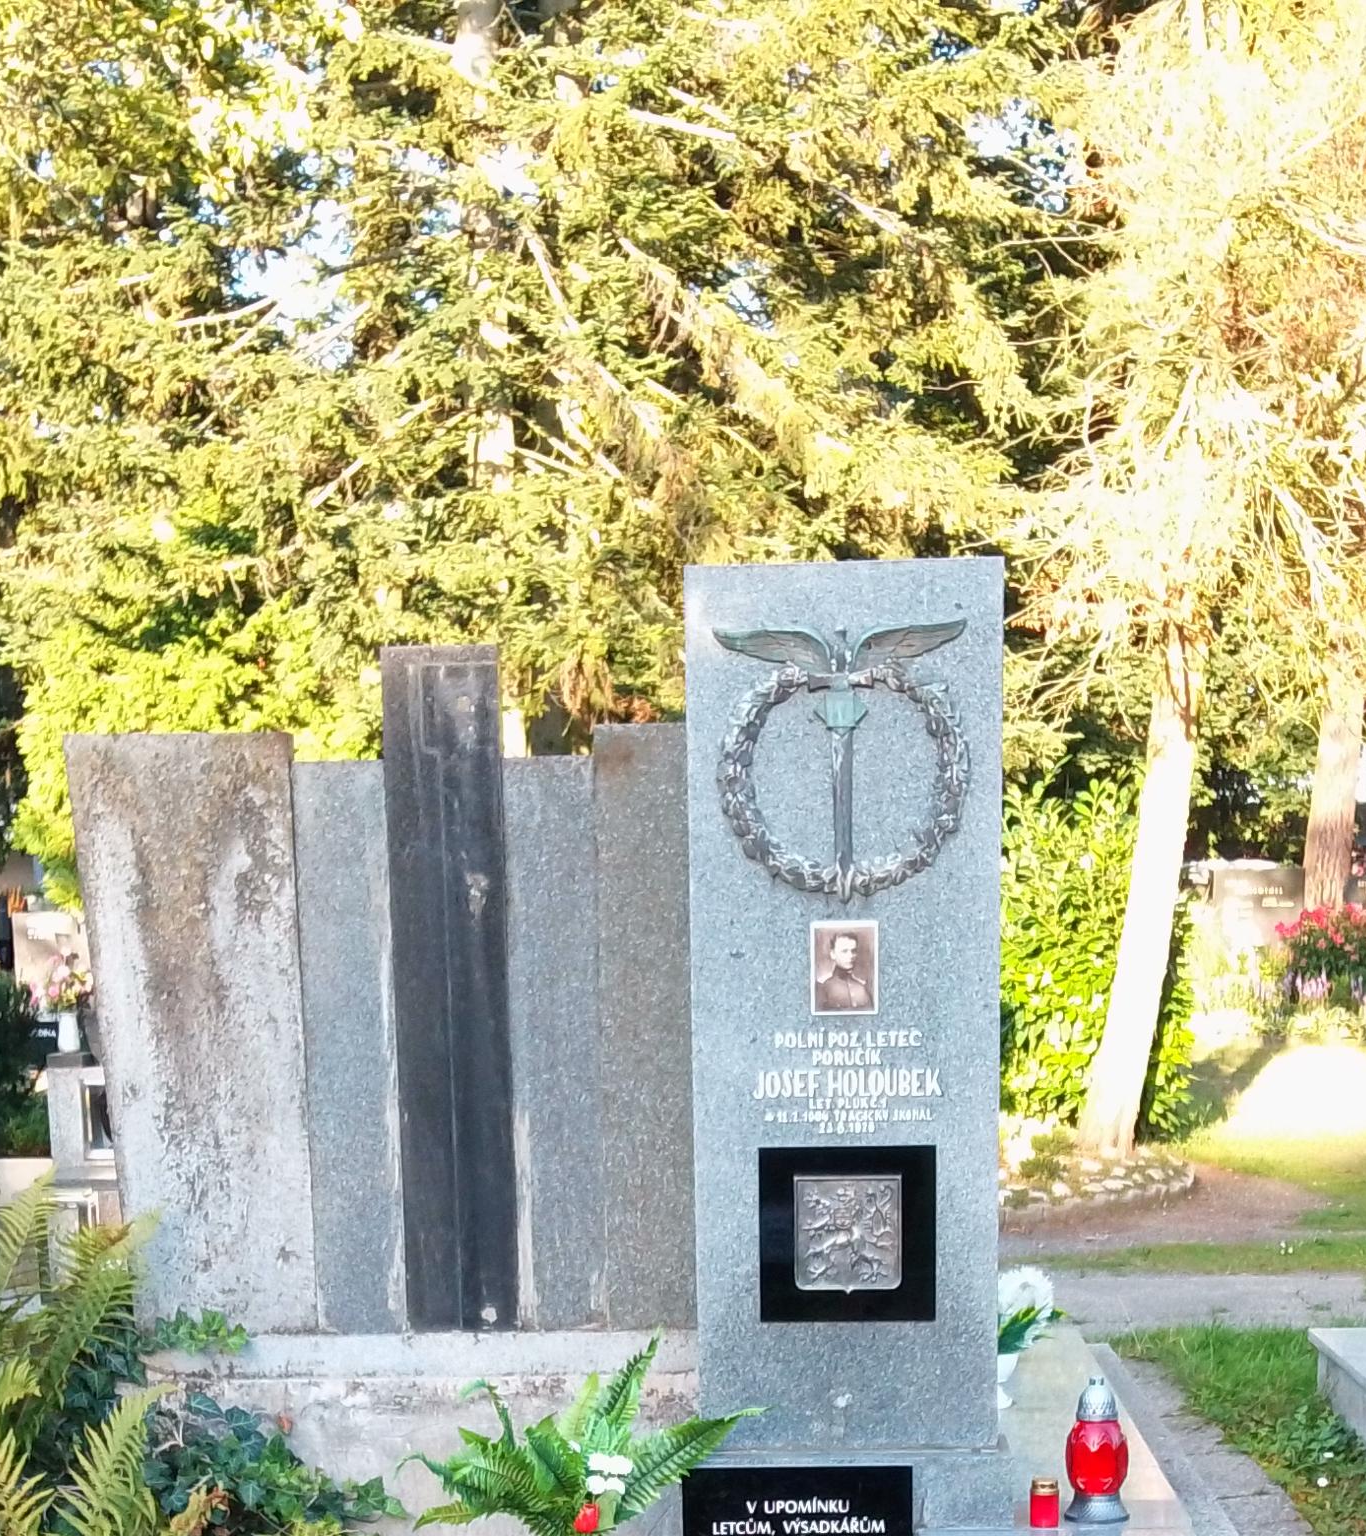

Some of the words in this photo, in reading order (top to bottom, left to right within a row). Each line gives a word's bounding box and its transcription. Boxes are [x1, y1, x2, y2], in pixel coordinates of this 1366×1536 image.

[775, 1027, 825, 1048] POLNÍ
[812, 1048, 882, 1066] PORUČÍK
[753, 1069, 821, 1100] JOSEF
[827, 1067, 944, 1098] HOLOUBEK
[746, 1501, 757, 1514] V
[764, 1497, 850, 1514] UPOMÍNKU
[712, 1518, 776, 1536] LETCŮM,
[783, 1516, 886, 1534] VÝSADKÁŘŮM
